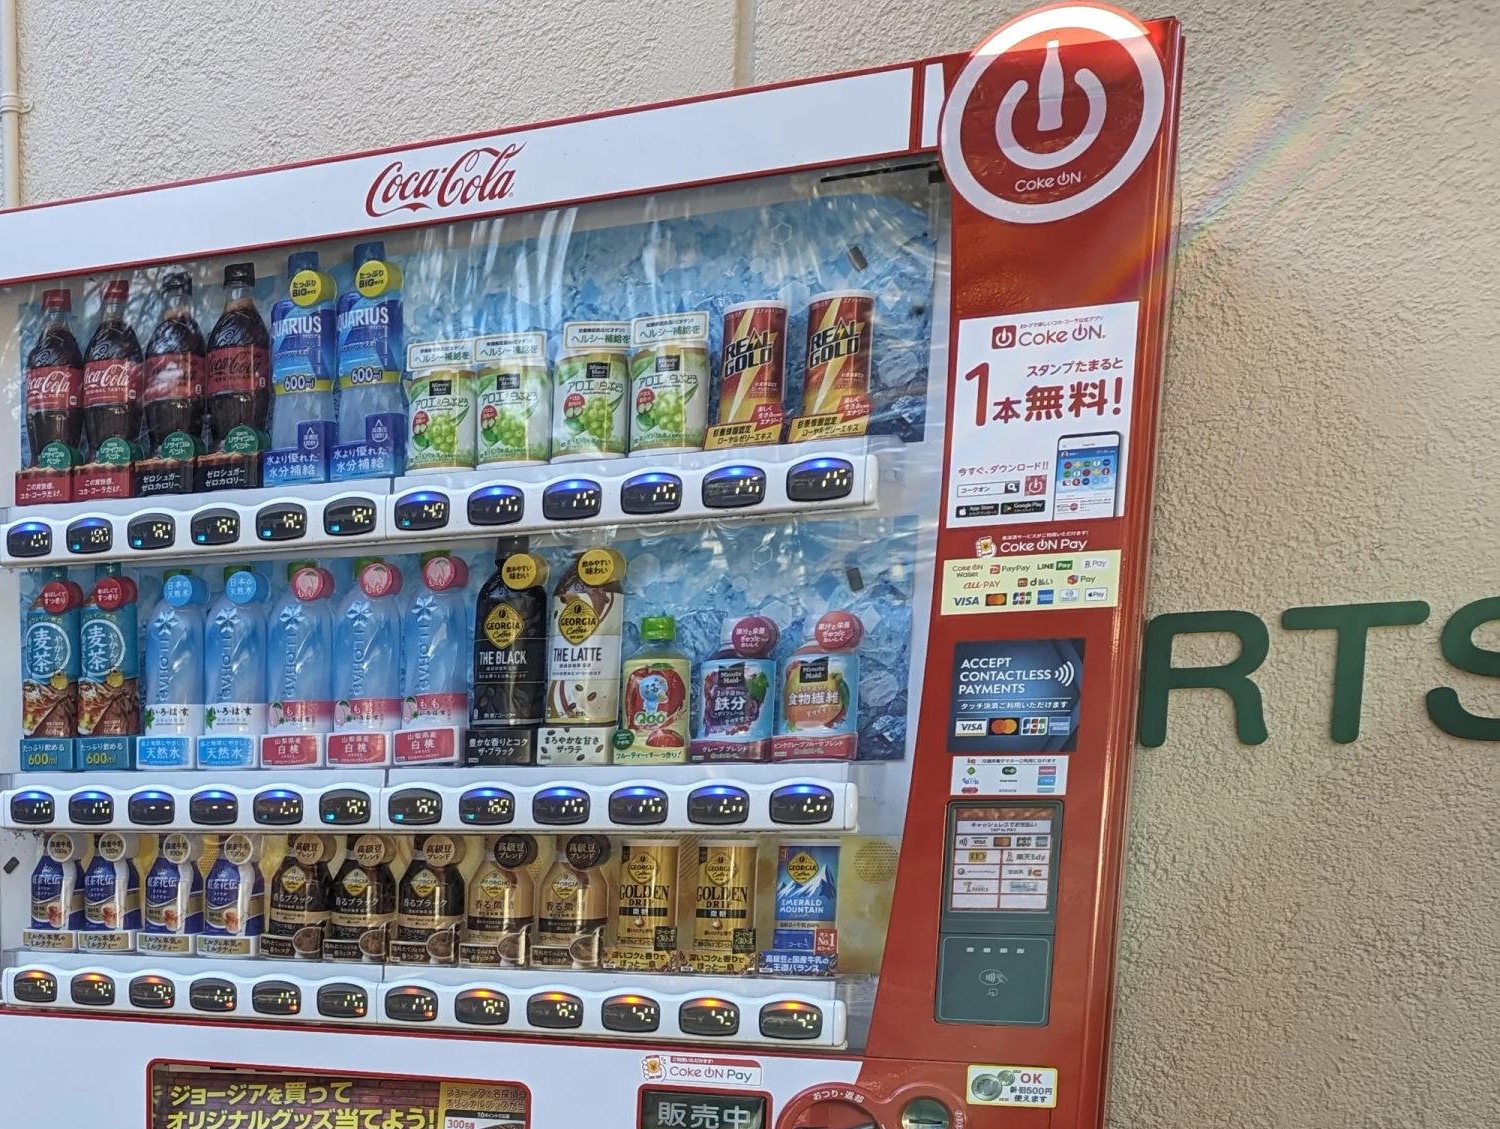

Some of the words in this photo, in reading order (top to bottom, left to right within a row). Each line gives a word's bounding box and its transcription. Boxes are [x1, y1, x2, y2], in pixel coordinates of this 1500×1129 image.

[365, 141, 527, 217] Coca-Cola
[1014, 176, 1054, 192] Coke
[810, 317, 860, 350] REAL
[1019, 330, 1068, 346] Coke
[726, 327, 773, 361] REAL
[809, 337, 860, 370] GOLD
[724, 346, 773, 380] GOLD
[1026, 357, 1124, 378] スタンプたまると
[718, 432, 772, 444] ローヤルゼリーエキス
[269, 463, 316, 478] 水分補給
[337, 457, 384, 472] 水分補給
[1000, 542, 1035, 553] Coke
[1060, 539, 1088, 551] Pay
[1002, 564, 1031, 574] PayPay
[1057, 561, 1072, 570] Pay
[1092, 559, 1107, 569] Pay
[509, 571, 530, 580] 味わい
[586, 566, 609, 576] 味わい
[984, 580, 1001, 589] PAY
[1080, 575, 1096, 584] Pay
[953, 597, 980, 606] VISA
[486, 621, 521, 631] GEORGIA
[560, 617, 598, 628] GEORGIA
[32, 628, 53, 672] 麦茶
[87, 625, 109, 670] 麦茶
[479, 651, 494, 666] THE
[495, 650, 528, 665] BLACK
[553, 648, 569, 662] THE
[571, 647, 602, 662] LATTE
[961, 657, 1012, 669] ACCEPT
[959, 670, 1052, 682] CONTACTLESS
[1140, 597, 1500, 748] RTS
[958, 683, 1025, 695] PAYMENTS
[420, 698, 440, 710] もも
[714, 697, 746, 711] 鉄分
[788, 693, 839, 706] 食物繊維
[634, 712, 666, 725] Qoo
[960, 723, 983, 731] VISA
[81, 742, 123, 751] たっぷり飲める
[411, 740, 435, 751] 白桃
[469, 737, 530, 747] 豊かな香りとコク
[544, 736, 600, 746] まろやかな甘さ
[22, 743, 65, 752] たっぷり飲める
[146, 747, 180, 759] 天然水
[207, 747, 243, 759] 天然水
[278, 745, 300, 755] 白桃
[345, 743, 367, 753] 白桃
[620, 885, 670, 900] GOLDEN
[697, 886, 748, 902] GOLDEN
[612, 951, 666, 960] 深いコクと香りで
[689, 954, 744, 963] 深いコクと香りで
[766, 955, 829, 964] 高級豆と国産牛乳の
[620, 960, 656, 968] ほっと一息
[698, 962, 734, 971] ほっと一息
[774, 963, 819, 972] 王道バランス
[670, 1066, 701, 1077] Coke
[727, 1069, 752, 1082] Pay
[1020, 1073, 1042, 1084] OK
[170, 1082, 353, 1106] ジョージアを買って
[1010, 1086, 1053, 1095] 新旧500円
[1014, 1095, 1048, 1103] 使えます
